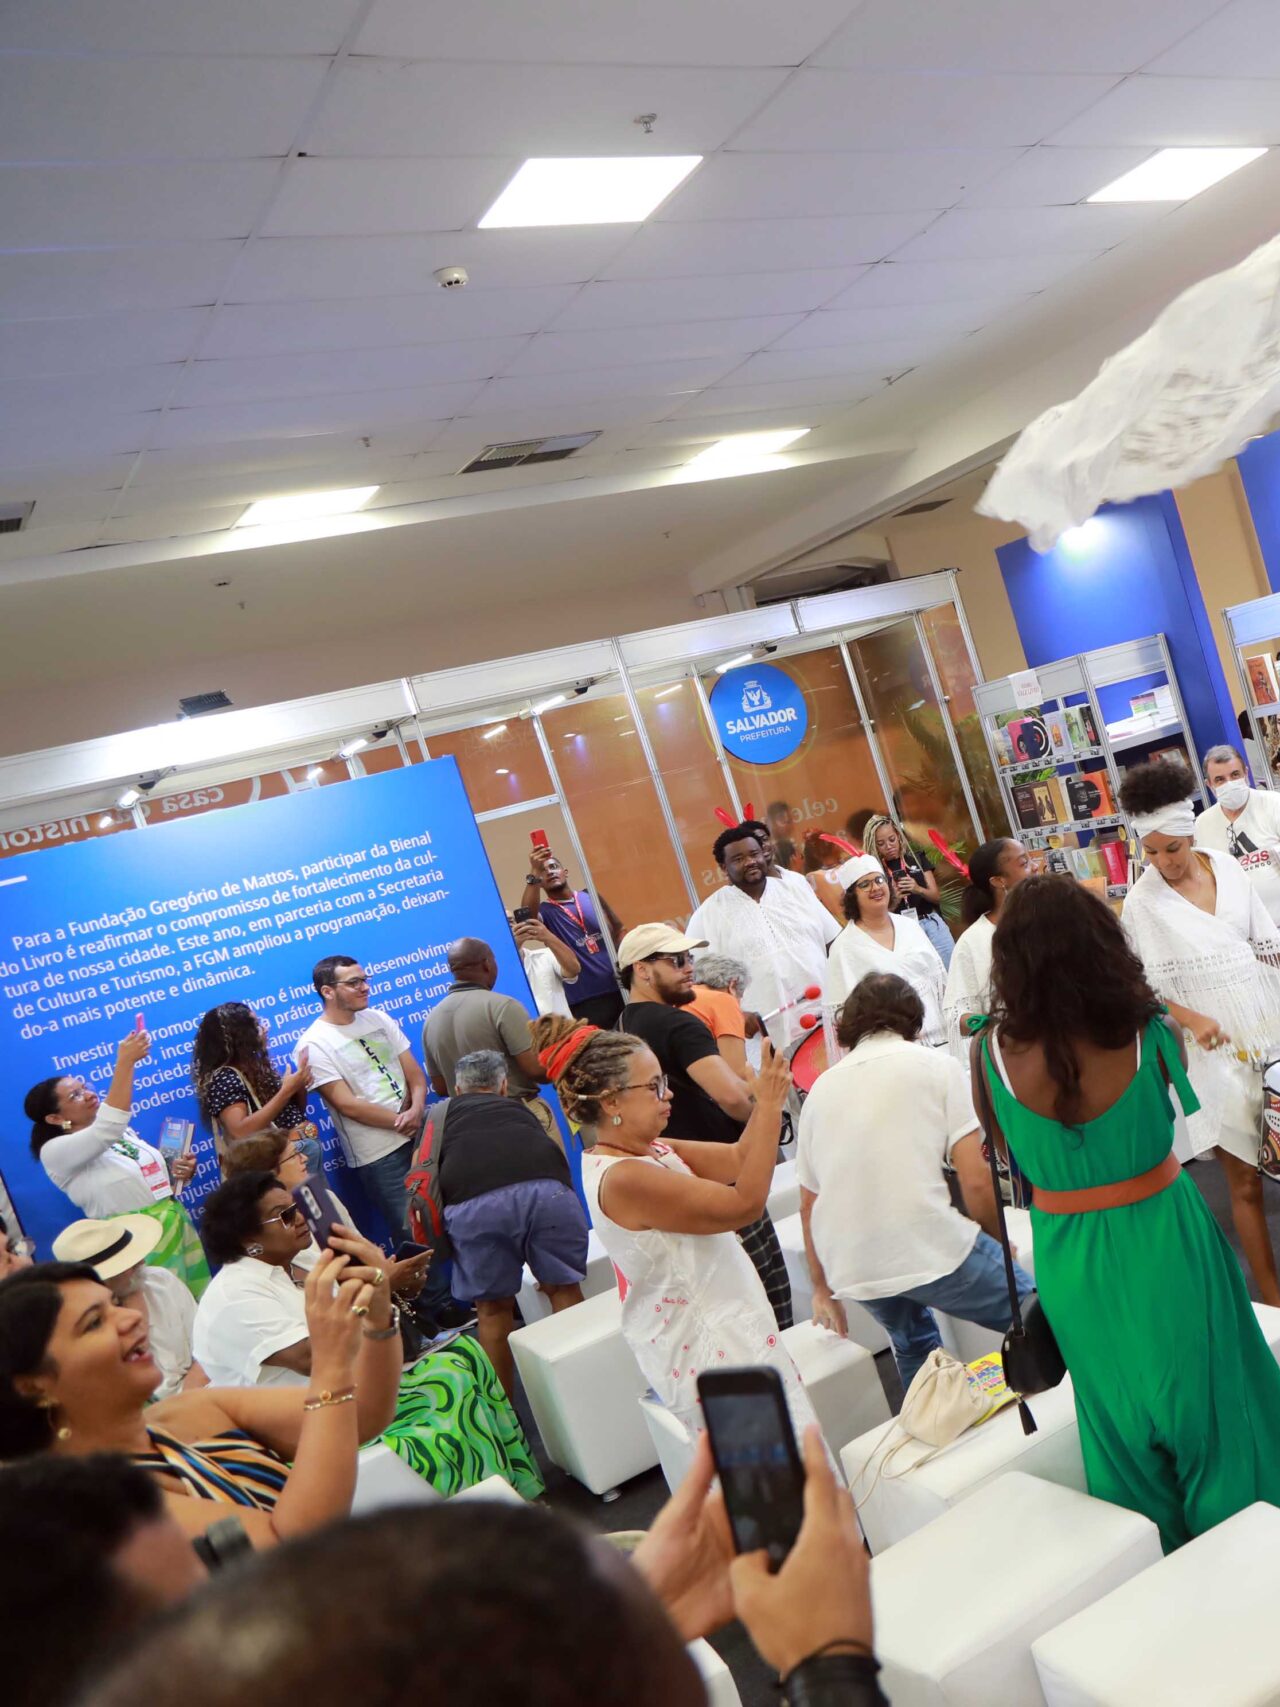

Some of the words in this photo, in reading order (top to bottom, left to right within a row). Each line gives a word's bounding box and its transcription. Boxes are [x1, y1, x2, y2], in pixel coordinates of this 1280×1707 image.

[725, 707, 798, 735] SALVADOR
[740, 725, 791, 743] PREFEITURA
[0, 961, 20, 978] do
[21, 950, 63, 972] Livro
[66, 944, 77, 959] é
[79, 926, 153, 957] reafirmar
[157, 923, 167, 936] o
[170, 895, 270, 932] compromisso
[272, 889, 290, 905] de
[292, 863, 392, 900] fortalecimento
[394, 857, 412, 872] da
[413, 850, 438, 867] cul-
[3, 979, 40, 999] tura
[43, 971, 65, 989] de
[68, 959, 115, 982] nossa
[118, 940, 176, 969] cidade.
[176, 932, 210, 952] Este
[213, 924, 248, 944] ano,
[249, 918, 272, 933] em
[275, 900, 333, 928] parceria
[335, 890, 365, 909] com
[368, 887, 377, 900] a
[377, 869, 444, 897] Secretaria
[12, 931, 51, 951] Para
[56, 928, 66, 940] a
[68, 907, 147, 937] Fundação
[150, 888, 218, 916] Gregório
[221, 882, 241, 898] de
[242, 867, 299, 892] Mattos,
[301, 849, 366, 880] participar
[370, 843, 388, 859] da
[389, 831, 432, 853] Bienal
[13, 1002, 35, 1020] de
[37, 984, 97, 1013] Cultura
[100, 982, 110, 995] e
[112, 964, 181, 992] Turismo,
[184, 960, 193, 973] a
[193, 947, 230, 969] FGM
[232, 931, 292, 959] ampliou
[294, 928, 303, 940] a
[305, 903, 401, 943] programação,
[402, 889, 450, 911] deixan-
[20, 1019, 59, 1040] do-a
[63, 1006, 102, 1029] mais
[104, 986, 166, 1020] potente
[169, 985, 180, 998] e
[182, 963, 256, 994] dinâmica.
[52, 1041, 113, 1071] Investir
[278, 988, 288, 1003] é
[288, 983, 317, 1000] inve
[364, 940, 453, 977] desenvolvime
[133, 1062, 194, 1091] socieda
[414, 986, 423, 1001] é
[160, 1040, 197, 1060] ince
[274, 1002, 322, 1030] prática
[394, 971, 416, 988] em
[419, 963, 451, 981] toda
